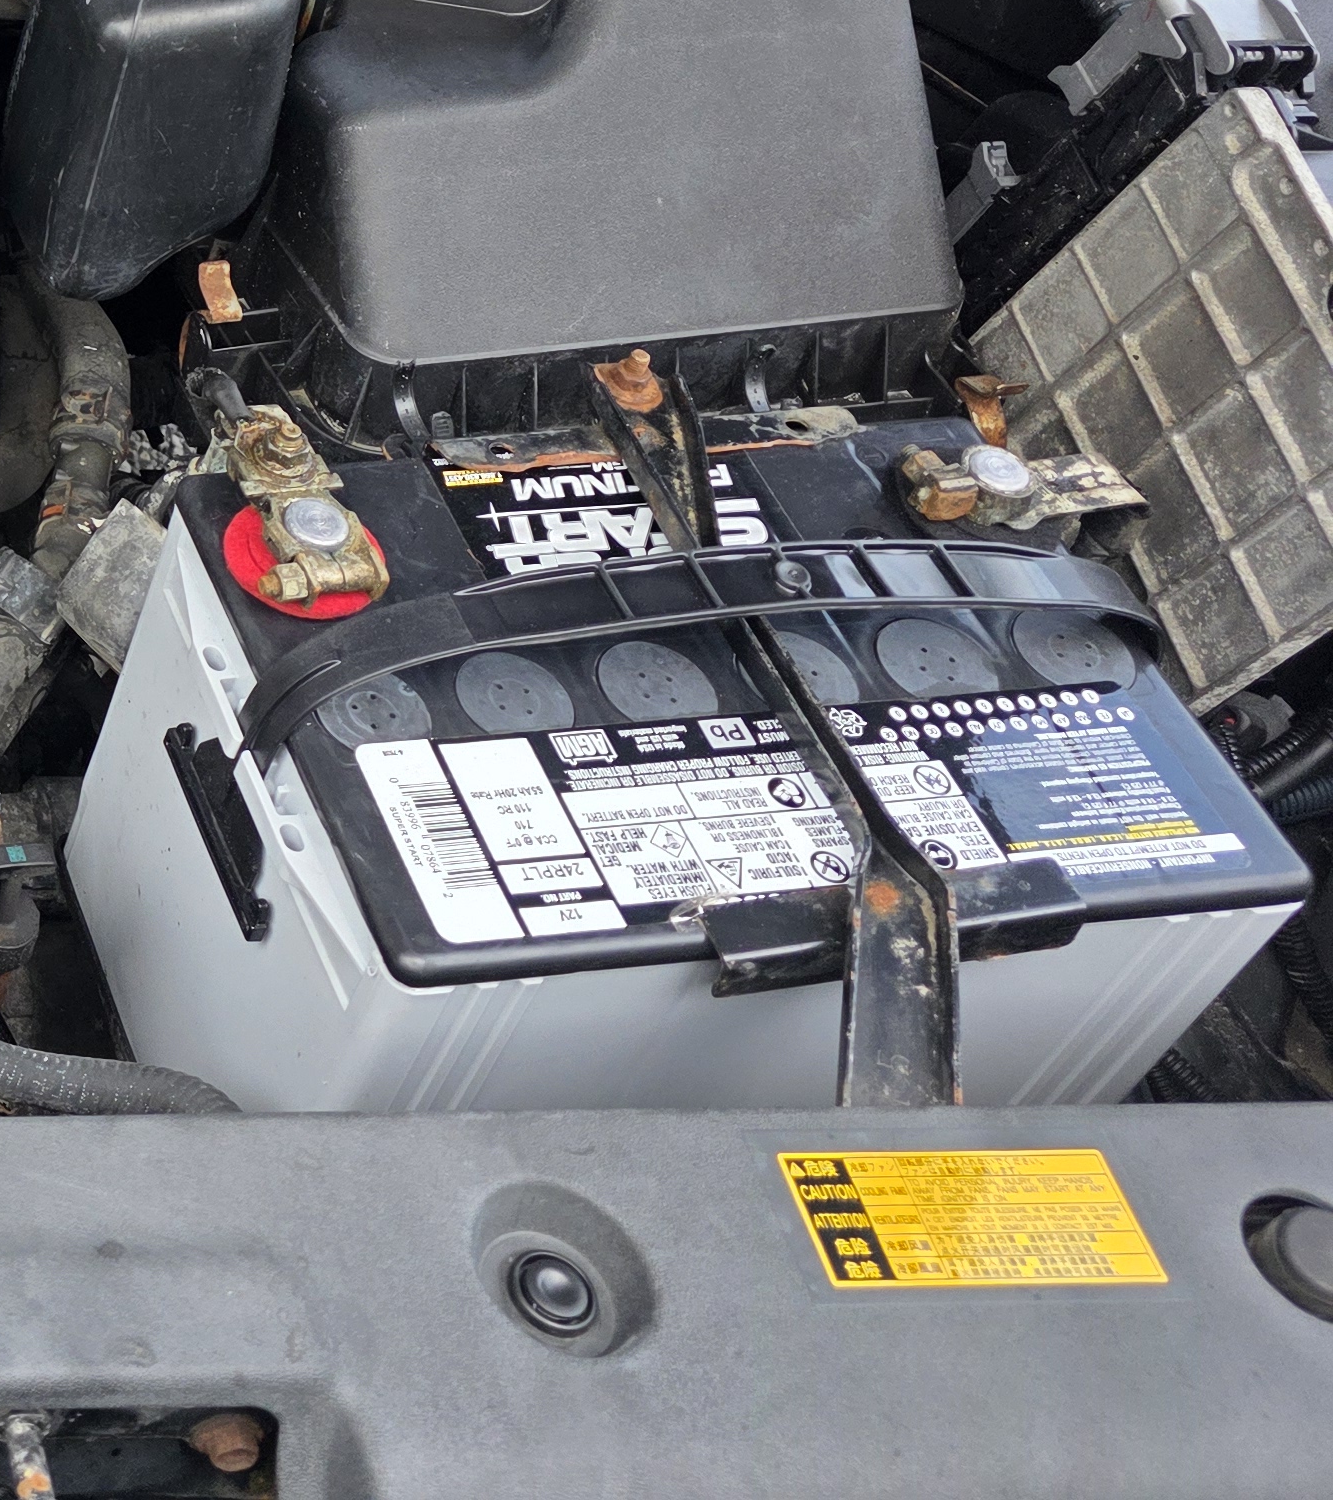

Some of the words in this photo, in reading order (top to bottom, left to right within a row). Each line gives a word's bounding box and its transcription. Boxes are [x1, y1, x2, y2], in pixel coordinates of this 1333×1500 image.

[708, 723, 747, 742] Pb
[756, 729, 790, 744] MUST
[554, 733, 610, 759] AGM
[898, 740, 919, 752] NOT
[677, 756, 714, 770] PROPER
[711, 753, 750, 768] FOLLOW
[748, 752, 772, 765] USE.
[861, 753, 885, 766] RISK
[883, 750, 930, 764] WARNING:
[563, 764, 633, 781] INSTRUCTIONS.
[631, 759, 678, 775] CHARGING
[714, 766, 730, 779] DO
[728, 764, 763, 778] BURNS.
[763, 763, 776, 775] OR
[620, 775, 634, 786] OR
[633, 769, 697, 785] DISASSEMBLE
[694, 768, 713, 781] NOT
[877, 773, 911, 787] REACH
[565, 777, 622, 792] INCINERATE.
[891, 783, 917, 796] KEEP
[469, 790, 493, 801] Rate
[690, 787, 762, 802] INSTRUCTIONS.
[496, 804, 512, 815] RC
[514, 802, 532, 814] 110
[672, 804, 689, 816] DO
[722, 800, 741, 811] ALL
[742, 797, 768, 809] READ
[912, 799, 950, 813] INJURY.
[949, 798, 966, 810] OR
[581, 809, 625, 824] BATTERY.
[627, 807, 651, 820] OPEN
[652, 805, 672, 818] NOT
[920, 810, 950, 822] CAUSE
[950, 808, 973, 819] CAN
[514, 819, 534, 830] 710
[697, 818, 736, 832] BURNS.
[735, 814, 772, 829] SEVERE
[791, 814, 836, 827] SMOKING
[618, 827, 648, 842] HELP
[722, 826, 779, 841] BLINDNESS
[804, 824, 843, 837] FLAMES
[920, 820, 981, 836] EXPLOSIVE
[388, 806, 408, 836] SUPER
[403, 837, 424, 867] START
[400, 801, 421, 830] 83996
[420, 844, 442, 874] 07864
[520, 833, 533, 846] @
[534, 833, 558, 846] CCA
[585, 829, 618, 844] FAST.
[709, 832, 722, 843] OR
[811, 835, 849, 849] SPARKS
[955, 833, 991, 847] EYES.
[590, 840, 643, 856] MEDICAL
[732, 841, 763, 854] CAUSE
[762, 840, 786, 852] CAN
[1115, 846, 1129, 856] TO
[1127, 842, 1169, 856] ATTEMPT
[1169, 841, 1189, 851] NOT
[1191, 839, 1207, 850] DO
[765, 851, 792, 863] ACID
[959, 847, 1000, 861] SHIELD
[1051, 850, 1087, 863] VENTS.
[1086, 848, 1115, 859] OPEN
[1158, 853, 1216, 868] IMPORTANT
[597, 855, 622, 868] GET
[669, 858, 702, 873] WITH
[1064, 859, 1152, 877] NONSERVICEABLE
[520, 862, 584, 882] 24RPLT
[625, 862, 669, 877] WATER.
[747, 864, 802, 880] SULFURIC
[632, 871, 708, 889] IMMEDIATELY
[540, 892, 559, 904] NO.
[557, 890, 582, 902] PART
[646, 887, 677, 901] EYES
[677, 883, 713, 899] FLUSH
[558, 908, 583, 922] 12V
[906, 1178, 921, 1187] TO
[924, 1178, 950, 1186] AVOID
[953, 1178, 998, 1186] PERSONAL
[1036, 1176, 1061, 1185] KEEP
[799, 1183, 859, 1200] CAUTION
[940, 1185, 965, 1194] FROM
[1044, 1185, 1071, 1194] START
[916, 1194, 936, 1203] TIME
[813, 1212, 871, 1228] ATTENTION
